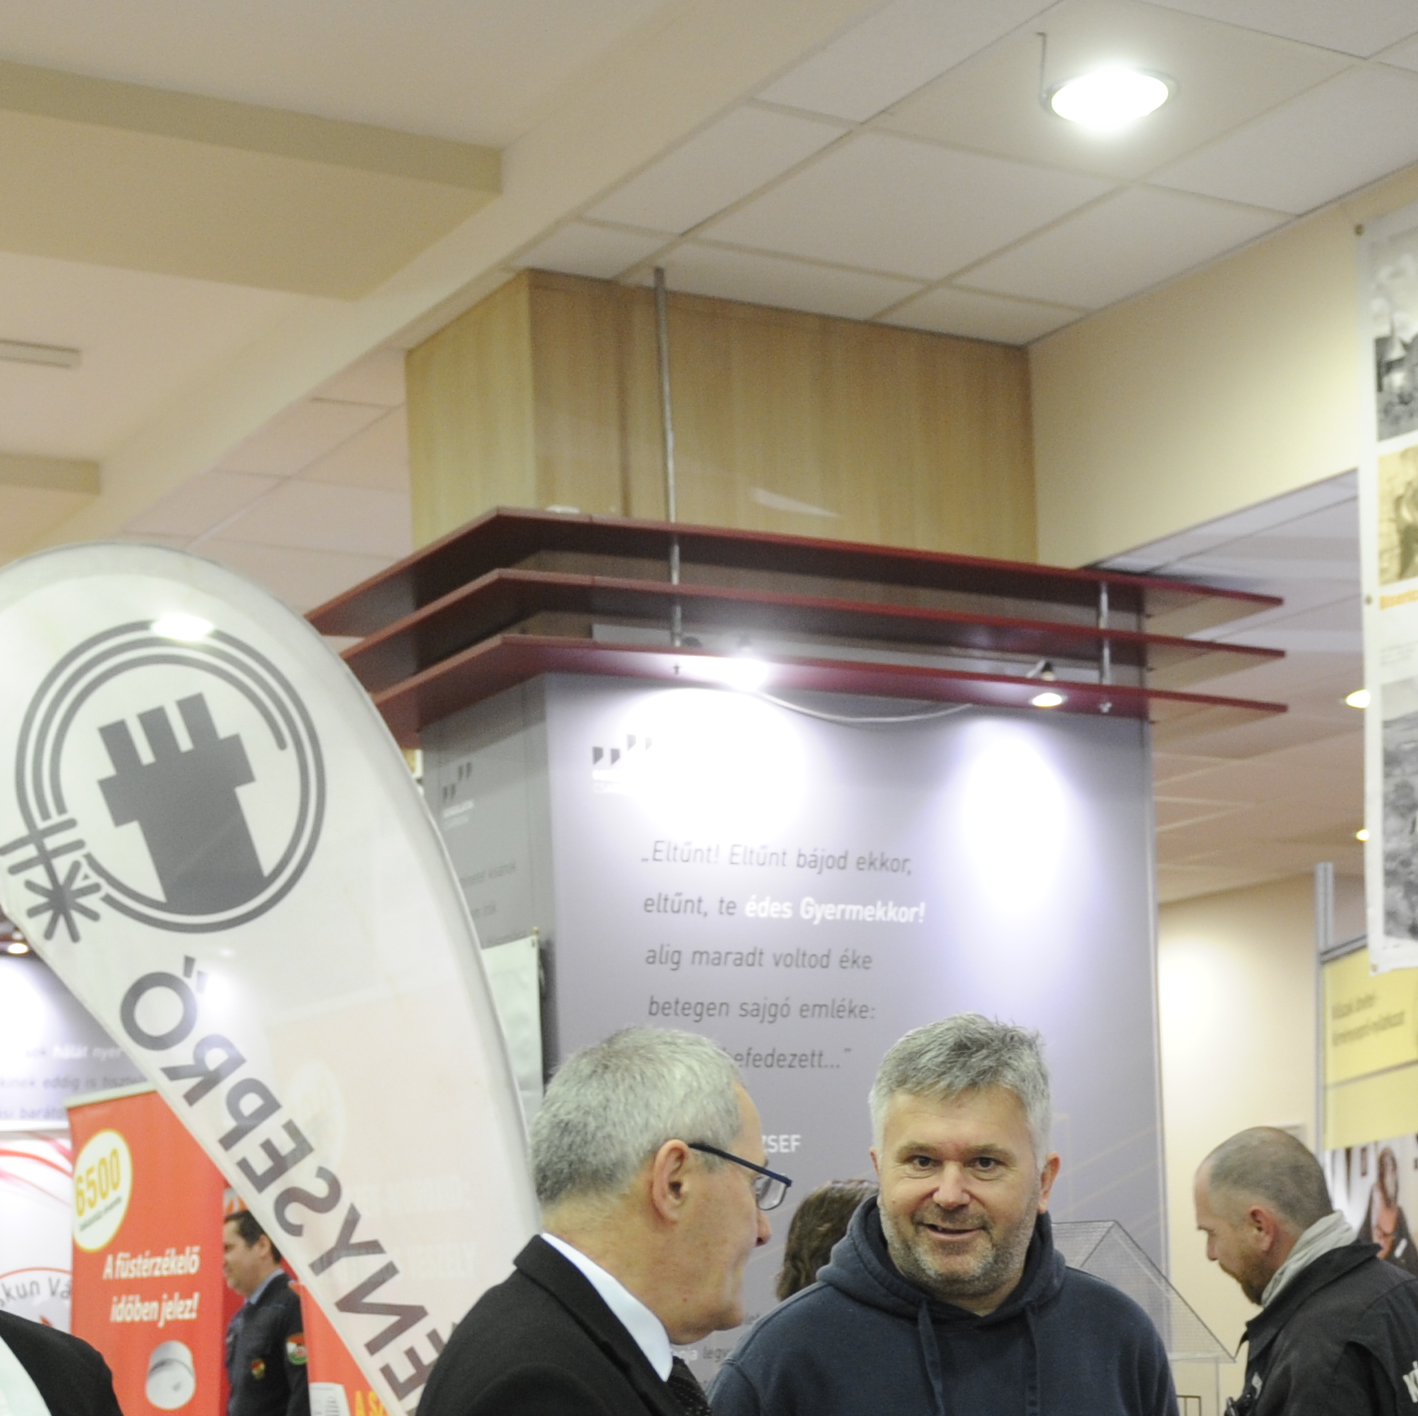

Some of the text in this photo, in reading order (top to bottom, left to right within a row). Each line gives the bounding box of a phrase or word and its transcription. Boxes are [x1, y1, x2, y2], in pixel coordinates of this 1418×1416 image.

[730, 843, 787, 868] Eltűnt
[796, 848, 848, 876] bájod
[856, 851, 913, 877] ekkor,
[643, 891, 926, 926] eltűnt, te édes Gyermekkor!
[645, 943, 873, 972] alig maradt voltod éke
[648, 995, 877, 1025] betegen sajgó emléke:
[761, 1134, 802, 1154] SEF
[74, 1147, 122, 1218] 6500
[102, 1245, 201, 1281] A füstérzékelő
[109, 1291, 201, 1329] időben jelez!
